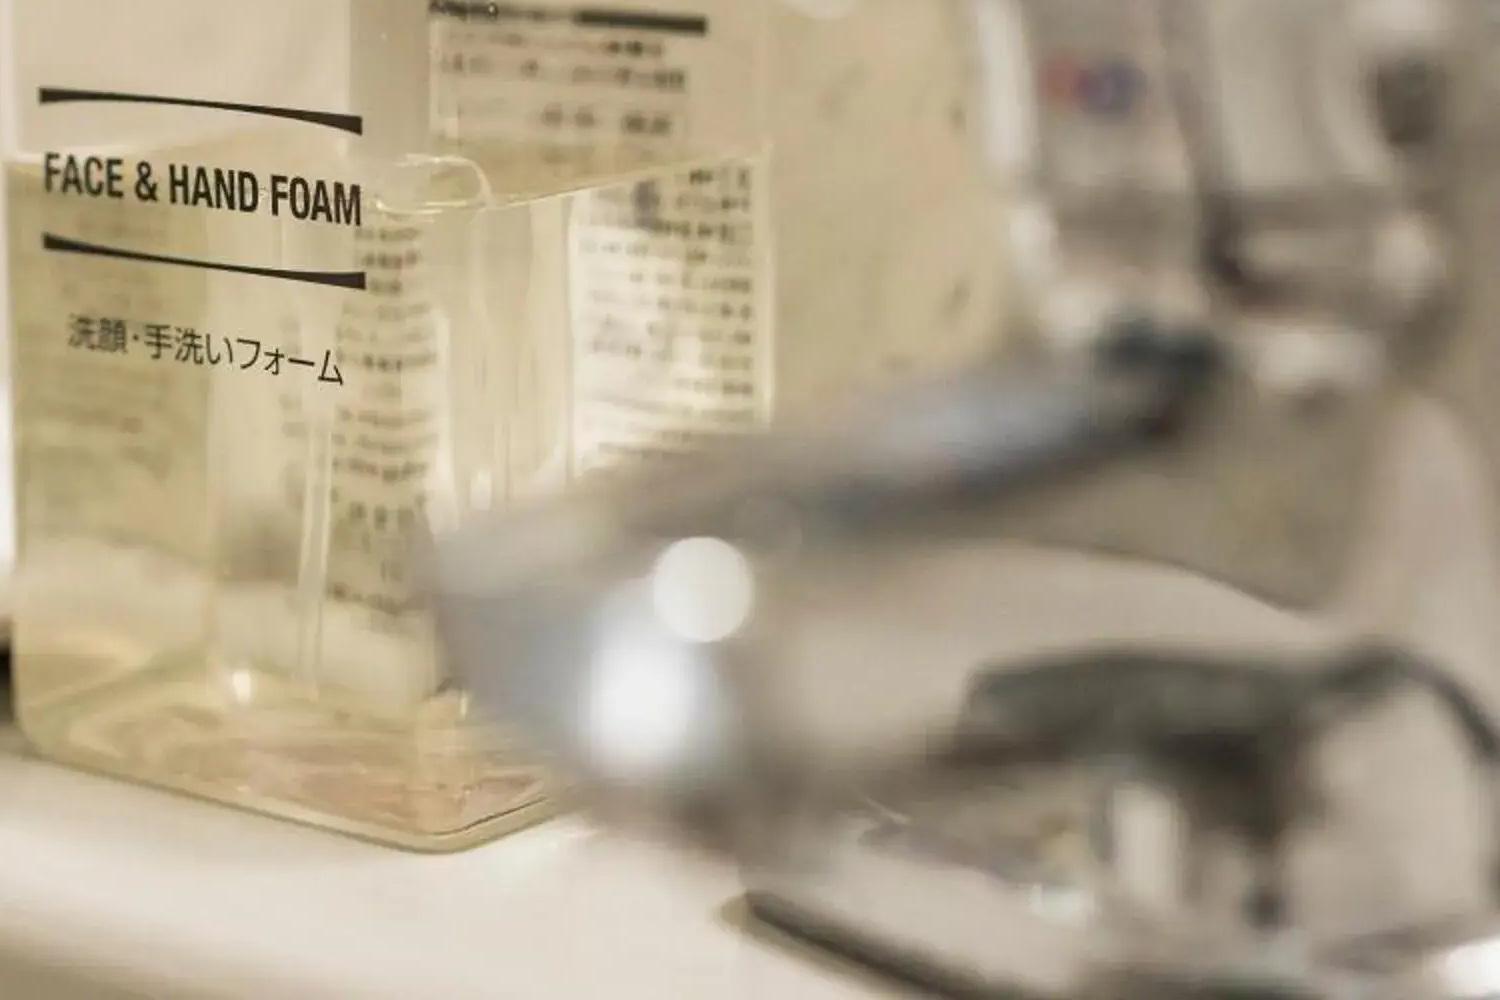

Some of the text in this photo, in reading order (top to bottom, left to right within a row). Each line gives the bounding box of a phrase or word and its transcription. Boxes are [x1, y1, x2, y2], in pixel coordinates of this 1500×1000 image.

[44, 152, 362, 226] FACE & HAND FOAM
[67, 314, 344, 385] 洗顔・手洗いフォーム
